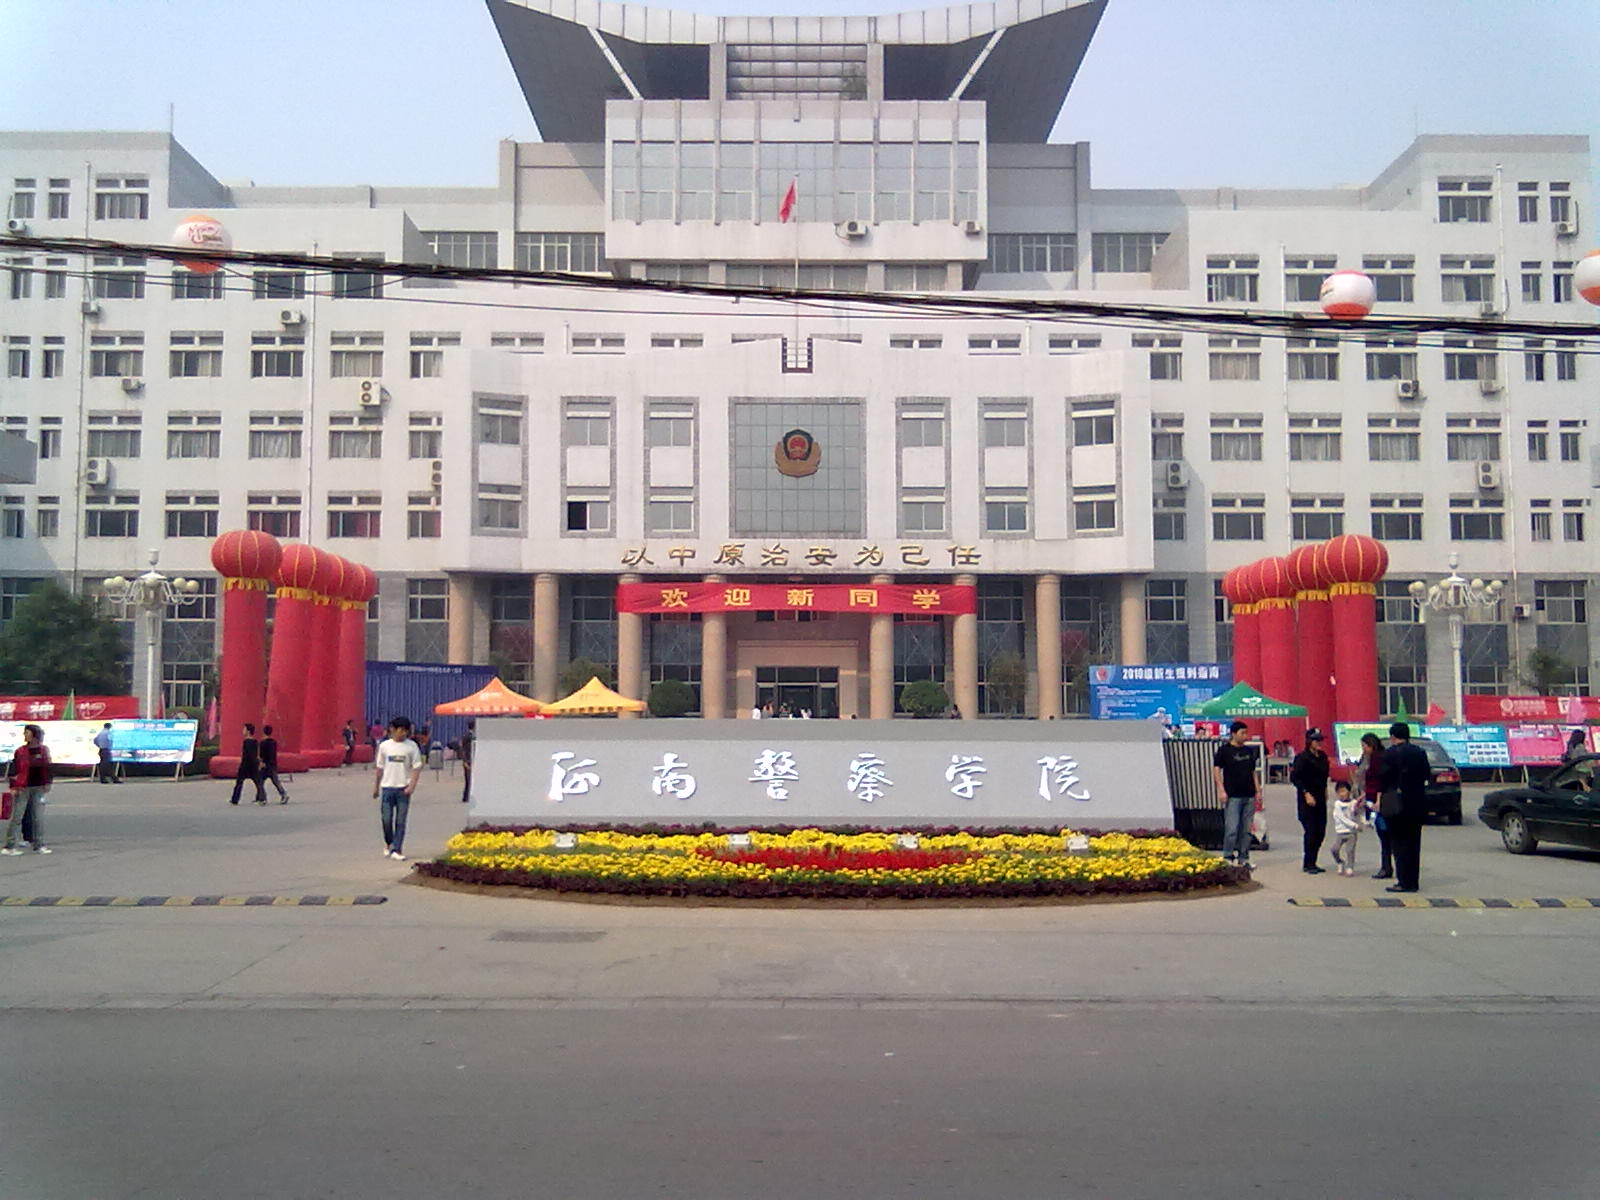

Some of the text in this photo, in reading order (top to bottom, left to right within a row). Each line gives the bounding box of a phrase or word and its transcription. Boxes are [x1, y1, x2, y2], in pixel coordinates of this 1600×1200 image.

[621, 543, 982, 567] 以中原治安为己任
[660, 587, 941, 609] 欢迎新同学
[549, 749, 1091, 802] 河南警察学院
